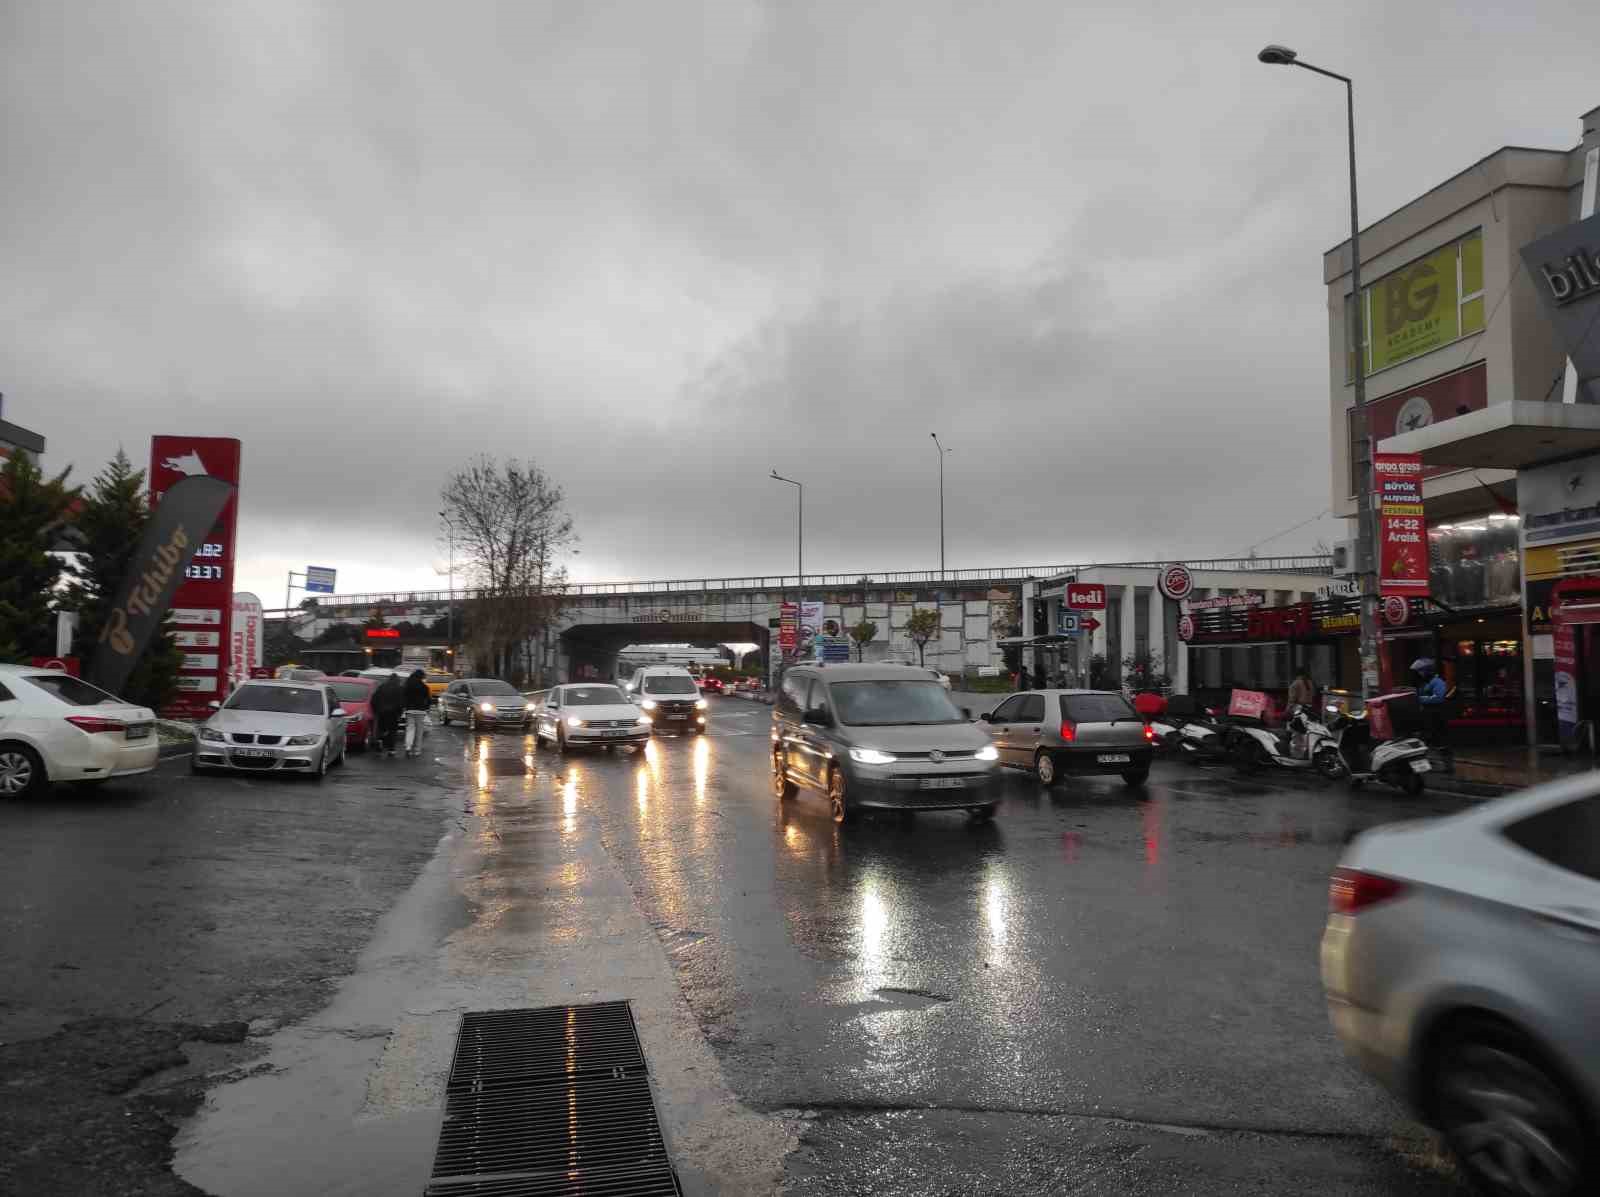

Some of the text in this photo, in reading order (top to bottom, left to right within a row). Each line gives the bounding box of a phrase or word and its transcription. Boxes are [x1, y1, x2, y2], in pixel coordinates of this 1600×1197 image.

[1384, 481, 1416, 491] BÜYÜK
[1388, 519, 1419, 530] 14-22
[127, 522, 188, 616] Tchibo
